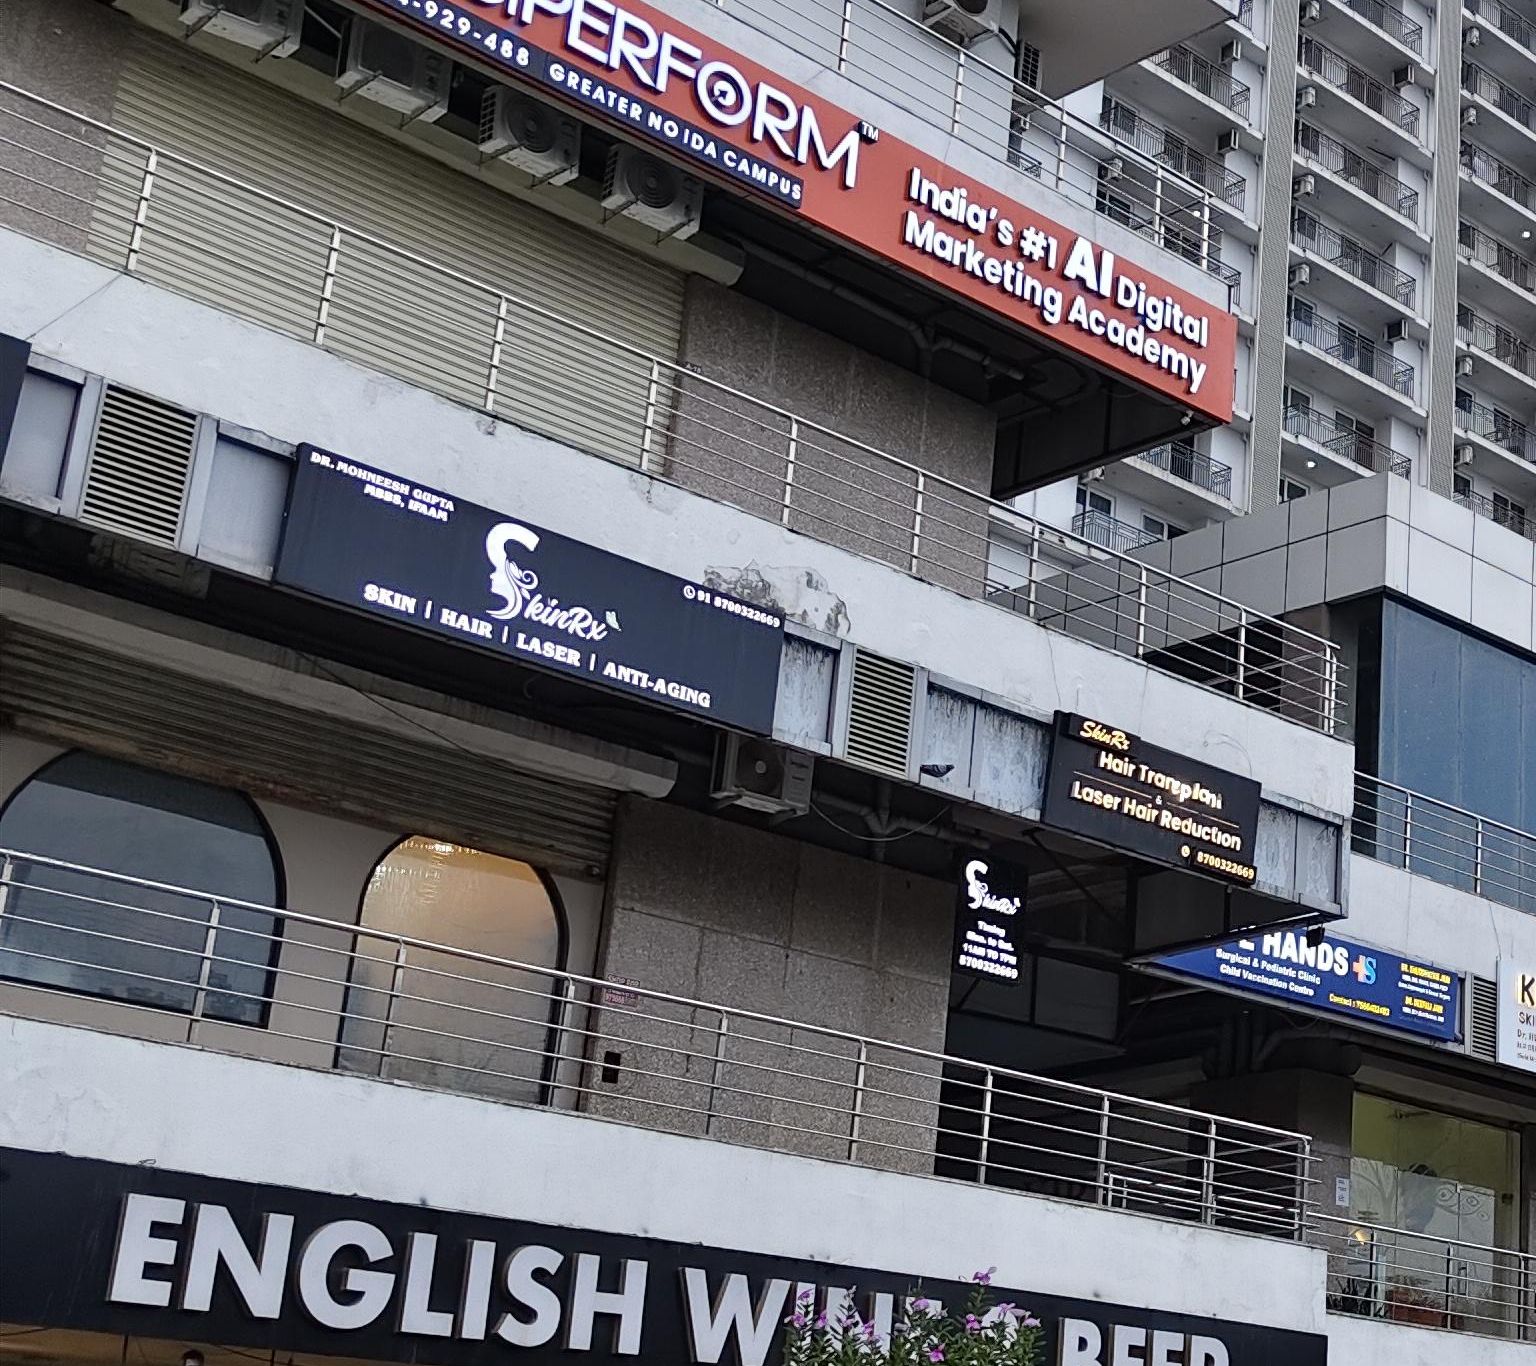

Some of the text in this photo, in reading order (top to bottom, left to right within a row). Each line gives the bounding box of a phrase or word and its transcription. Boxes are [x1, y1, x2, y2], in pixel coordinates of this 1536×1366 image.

[548, 63, 642, 122] GREATER
[723, 149, 802, 201] CAMPUS
[909, 167, 1209, 348] India's #1 AI Digital
[905, 211, 1207, 395] Marketing Academy
[309, 451, 455, 512] DR. MOHNEESH GUPTA
[713, 596, 781, 628] 8700322669
[363, 583, 712, 708] SKIN HAIR LASER ANTI-AGING
[1098, 750, 1137, 778] Hair
[1071, 780, 1242, 852] Laser Hair Reduction
[1155, 795, 1163, 805] &
[1196, 851, 1255, 880] 8700322669
[1215, 948, 1321, 985] Surgical & Pediatric Clinic
[1219, 963, 1315, 997] Child Vaccination Centre
[1262, 931, 1349, 976] HANDS
[106, 1192, 649, 1356] ENGLISH
